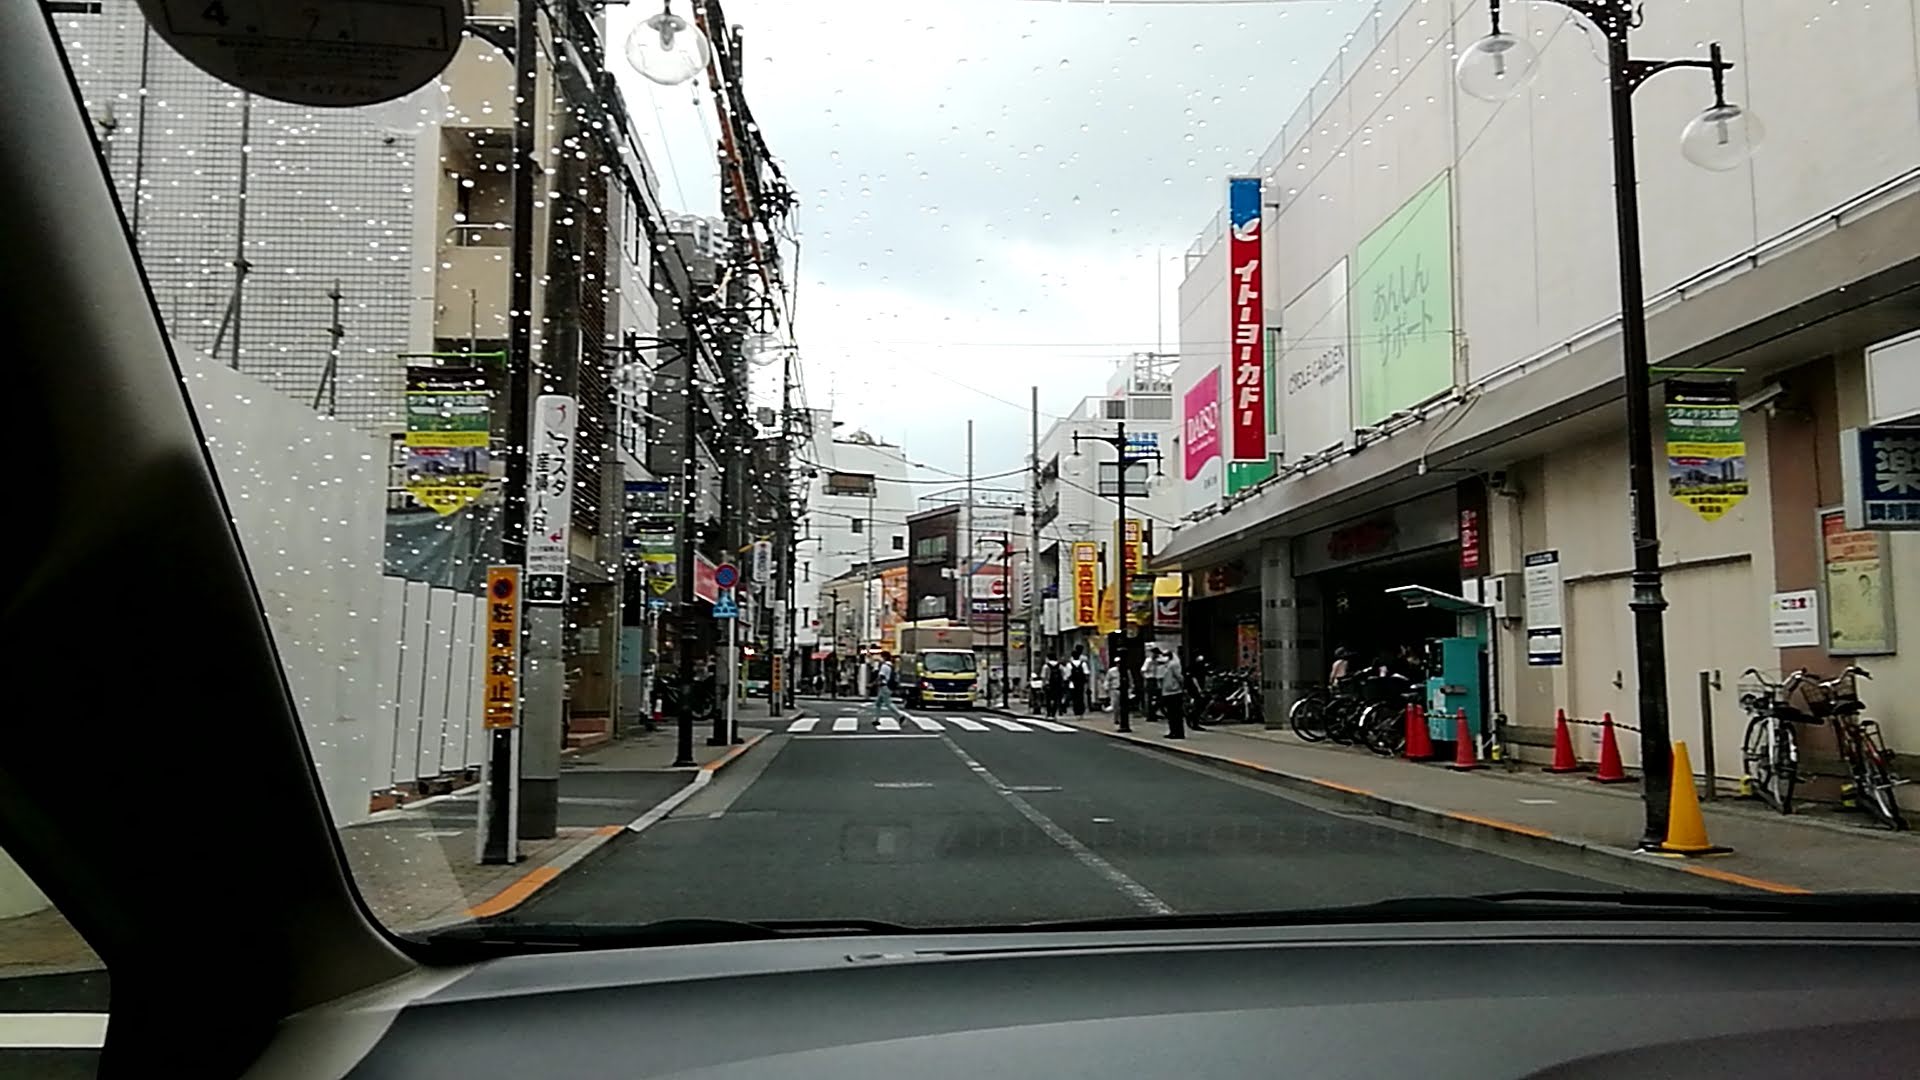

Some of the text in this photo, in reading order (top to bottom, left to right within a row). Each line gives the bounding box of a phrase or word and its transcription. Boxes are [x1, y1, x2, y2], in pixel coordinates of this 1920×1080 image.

[1374, 253, 1429, 322] あんしん
[1233, 258, 1261, 426] イトーヨーカドー
[1378, 301, 1433, 367] サポート
[1288, 345, 1345, 395] CYCLE GARDEN
[1187, 401, 1219, 444] DAISO
[1872, 436, 1920, 495] 薬
[1078, 564, 1094, 623] 高価買取
[489, 602, 514, 703] 駐車禁止
